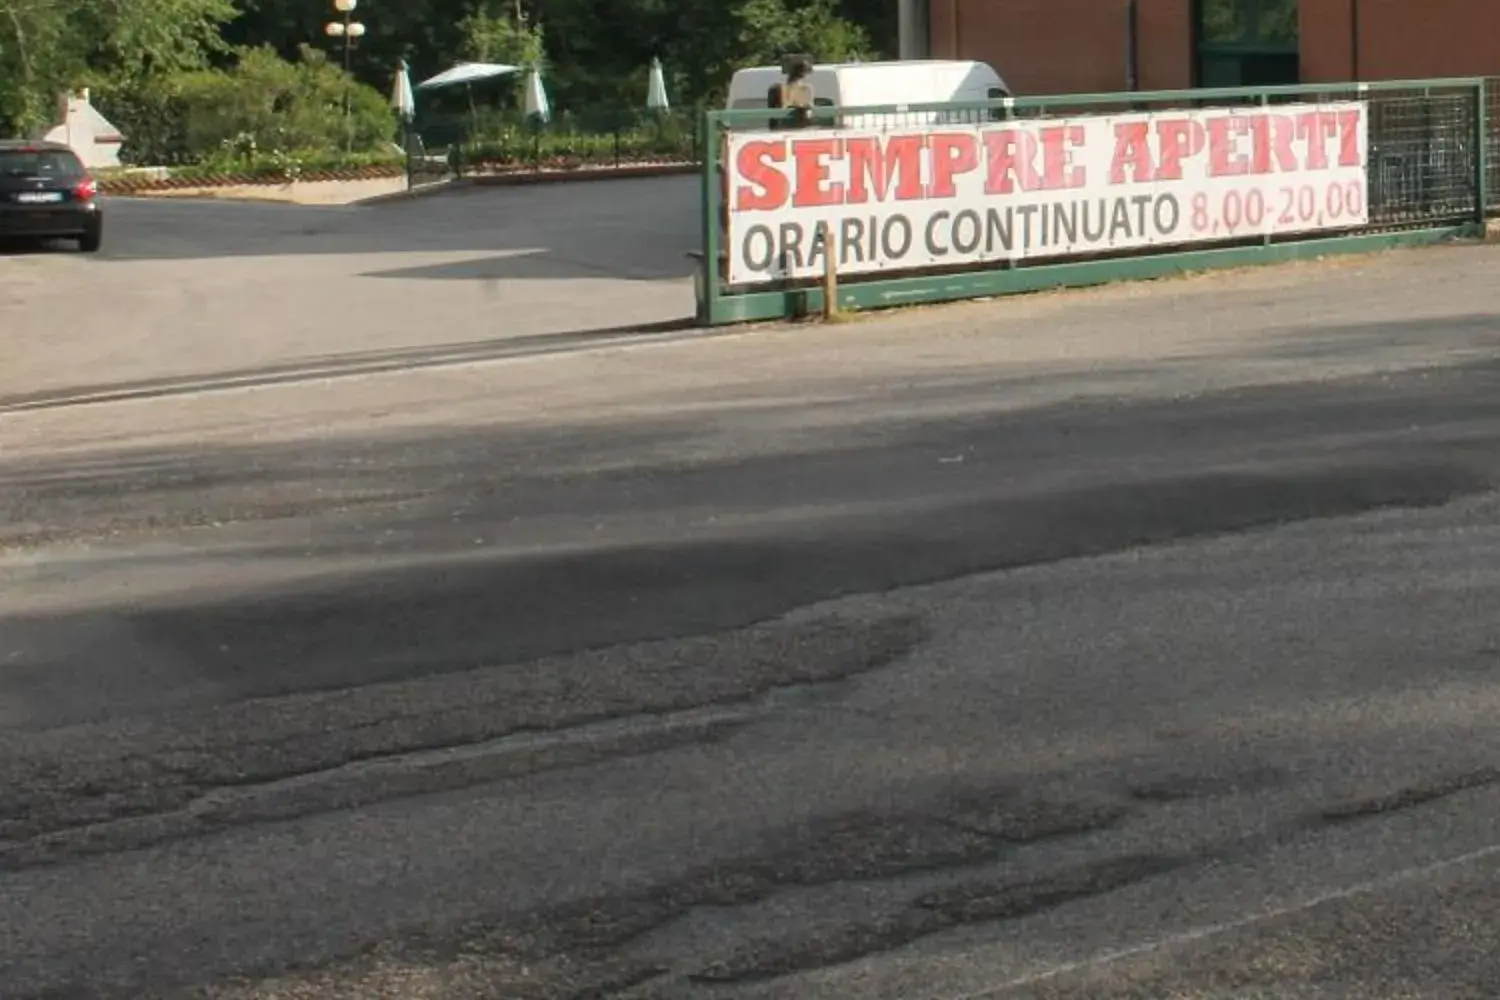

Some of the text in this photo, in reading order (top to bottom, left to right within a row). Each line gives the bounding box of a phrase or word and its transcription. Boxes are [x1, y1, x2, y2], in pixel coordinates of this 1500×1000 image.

[736, 109, 1361, 212] SEMPRE APERTI
[742, 179, 1363, 272] ORARIO CONTINUATO 8,00-20,00
